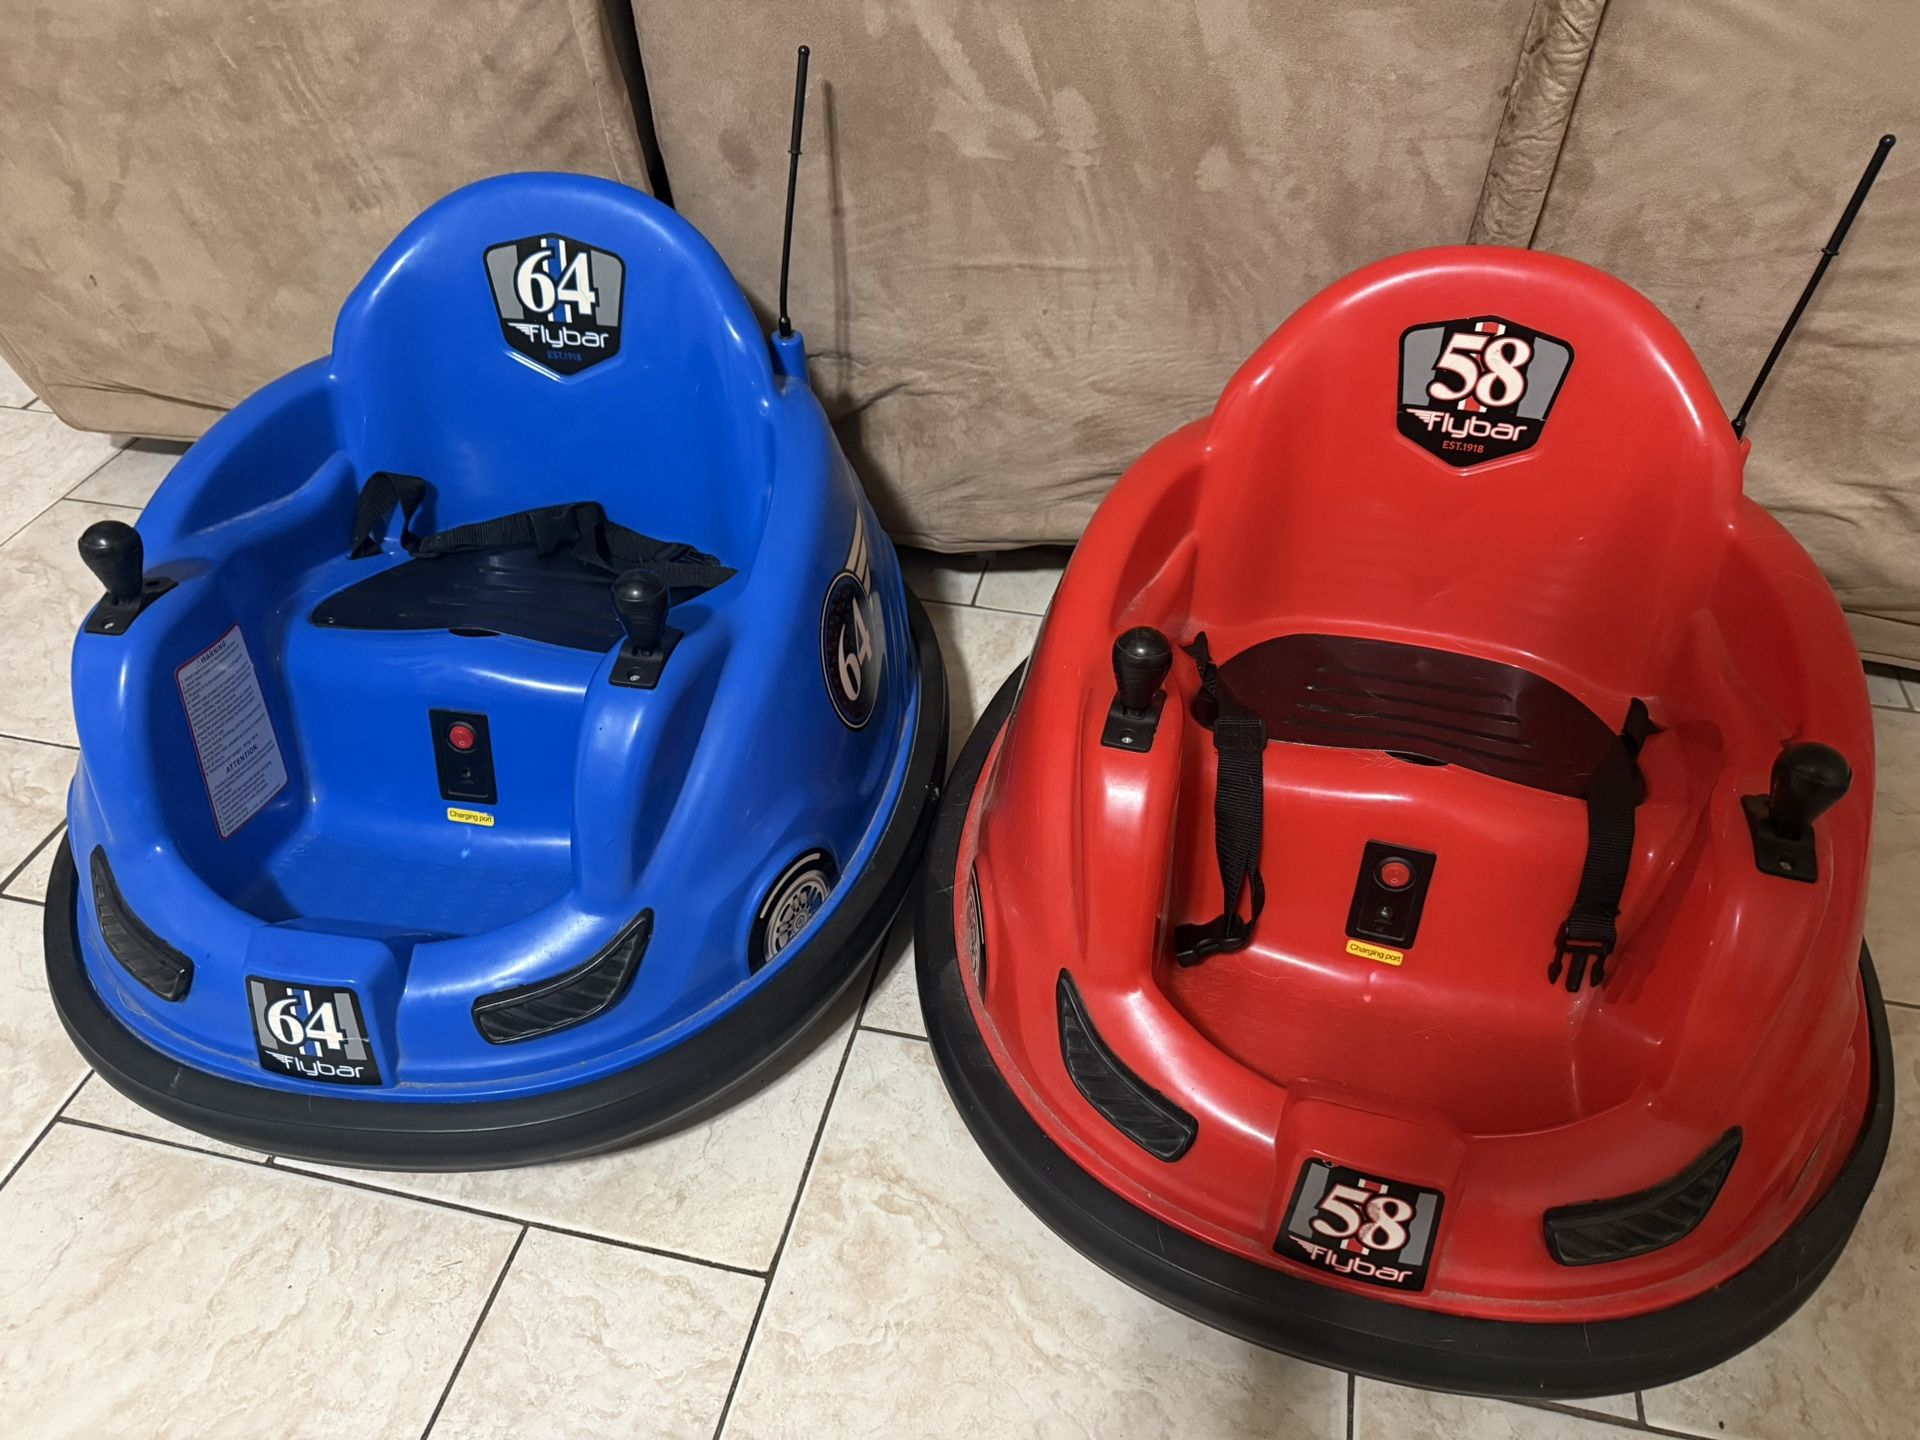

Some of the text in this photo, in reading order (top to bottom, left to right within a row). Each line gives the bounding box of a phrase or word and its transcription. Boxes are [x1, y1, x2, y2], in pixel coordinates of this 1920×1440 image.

[517, 250, 597, 315] 64
[1428, 332, 1531, 407] 58
[1442, 440, 1484, 453] EST.1918
[838, 597, 872, 700] 64
[449, 810, 492, 823] Charging port
[1349, 943, 1401, 962] Charging port
[267, 998, 344, 1050] 64
[1311, 1183, 1414, 1251] 58
